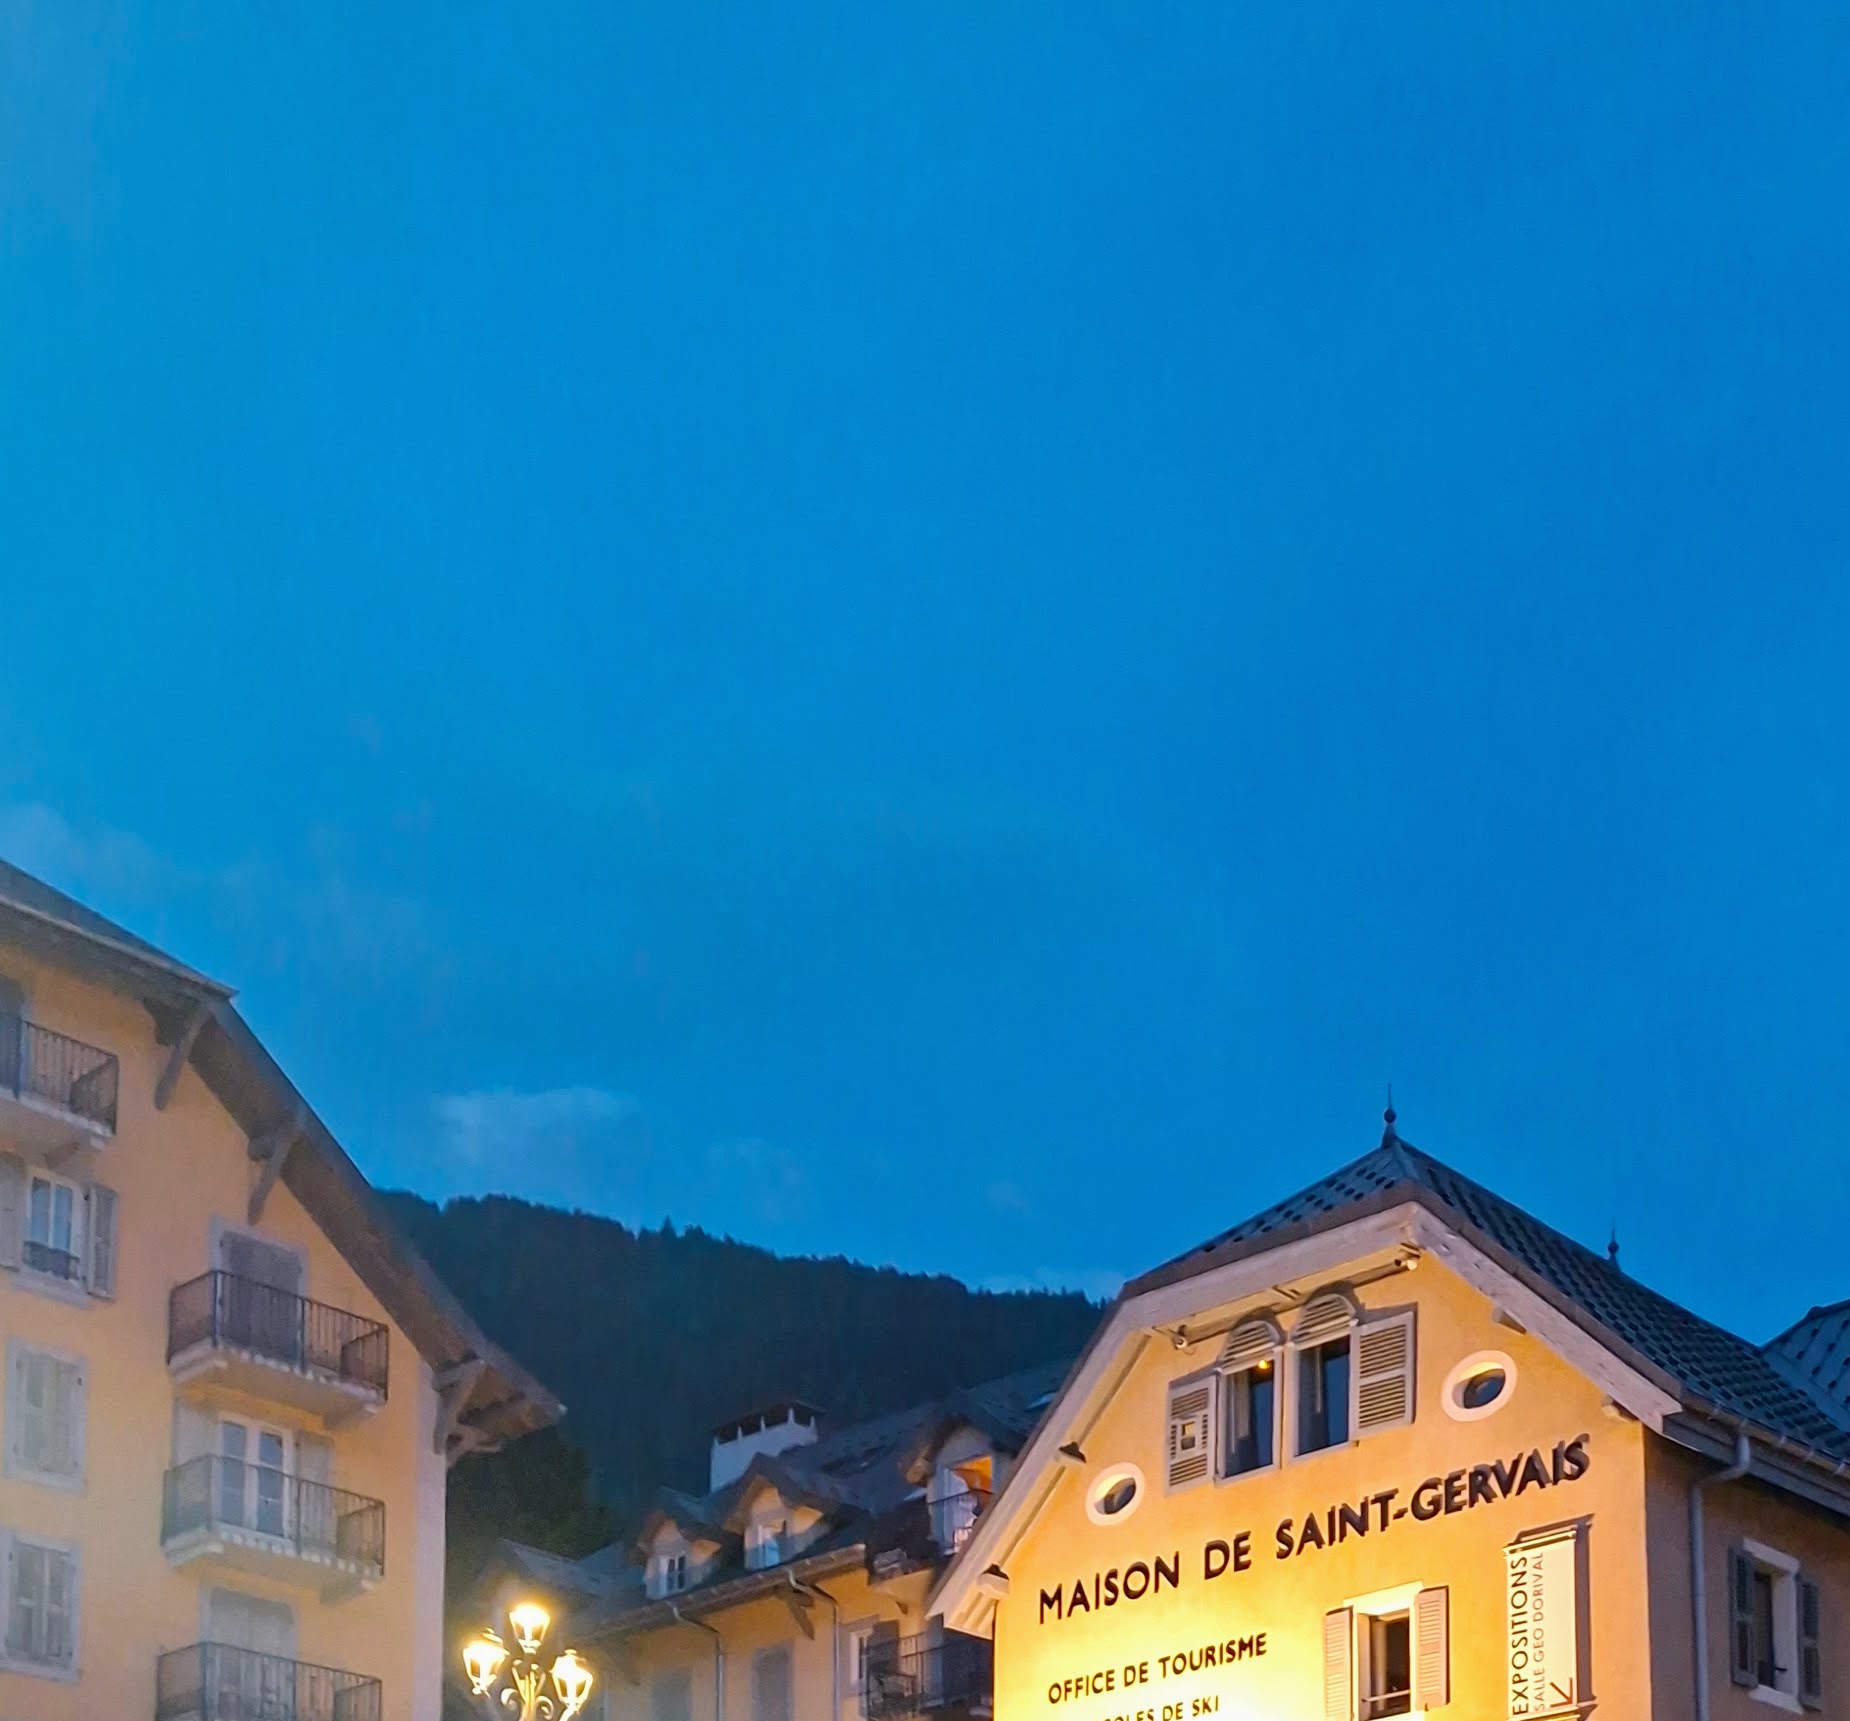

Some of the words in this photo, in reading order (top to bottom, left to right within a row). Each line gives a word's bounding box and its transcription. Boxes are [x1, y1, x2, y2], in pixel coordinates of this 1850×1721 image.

[1039, 1551, 1180, 1625] MAISON
[1204, 1531, 1252, 1581] DE
[1275, 1432, 1591, 1560] SAINT-GERVAIS
[1532, 1552, 1544, 1622] DORIVAL
[1048, 1669, 1115, 1704] OFFICE
[1123, 1661, 1149, 1687] DE
[1158, 1632, 1267, 1679] TOURISME
[1511, 1556, 1529, 1716] EXPOSITIONS
[1533, 1628, 1545, 1663] GEO
[1192, 1695, 1220, 1718] SKI
[1533, 1667, 1545, 1712] SALLE
